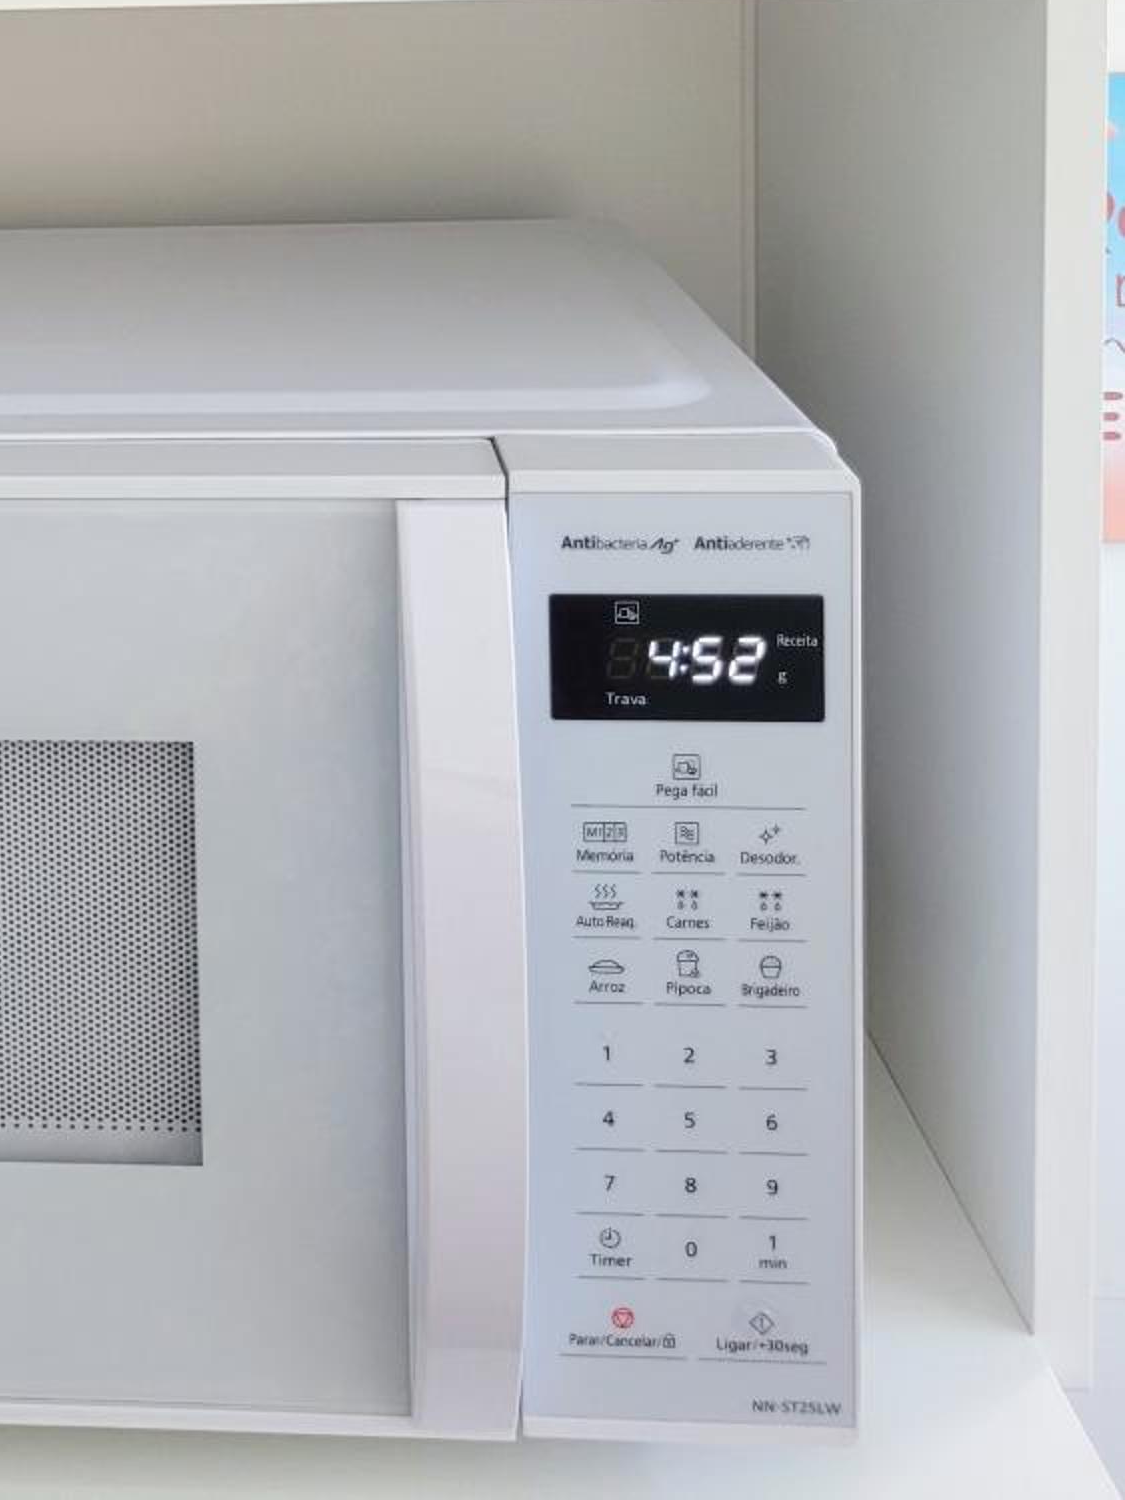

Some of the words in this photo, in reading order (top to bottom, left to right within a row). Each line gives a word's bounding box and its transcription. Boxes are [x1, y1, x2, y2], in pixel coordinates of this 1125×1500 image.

[561, 535, 648, 551] Antibacteria
[694, 535, 785, 551] Antiaderente
[776, 633, 819, 648] Receita
[606, 692, 647, 706] Trava
[656, 783, 688, 800] Pega
[576, 848, 635, 863] Memória
[659, 848, 716, 863] Potência
[739, 851, 801, 865] Desodor.
[576, 915, 604, 928] Auto
[666, 915, 710, 929] Carnes
[750, 916, 791, 933] Feijão
[588, 979, 626, 994] Arroz
[666, 981, 712, 998] Pipoca
[741, 982, 801, 999] Brigadeiro
[603, 1046, 611, 1061] 1
[682, 1047, 696, 1065] 2
[765, 1049, 778, 1066] 3
[602, 1110, 615, 1126] 4
[683, 1111, 697, 1129] 5
[765, 1113, 779, 1132] 6
[604, 1174, 616, 1191] 7
[683, 1176, 698, 1194] 8
[765, 1178, 779, 1196] 9
[685, 1240, 699, 1258] 0
[769, 1235, 777, 1250] 1
[590, 1253, 632, 1268] Timer
[759, 1256, 788, 1269] min
[752, 1399, 842, 1416] NN-ST25LW
